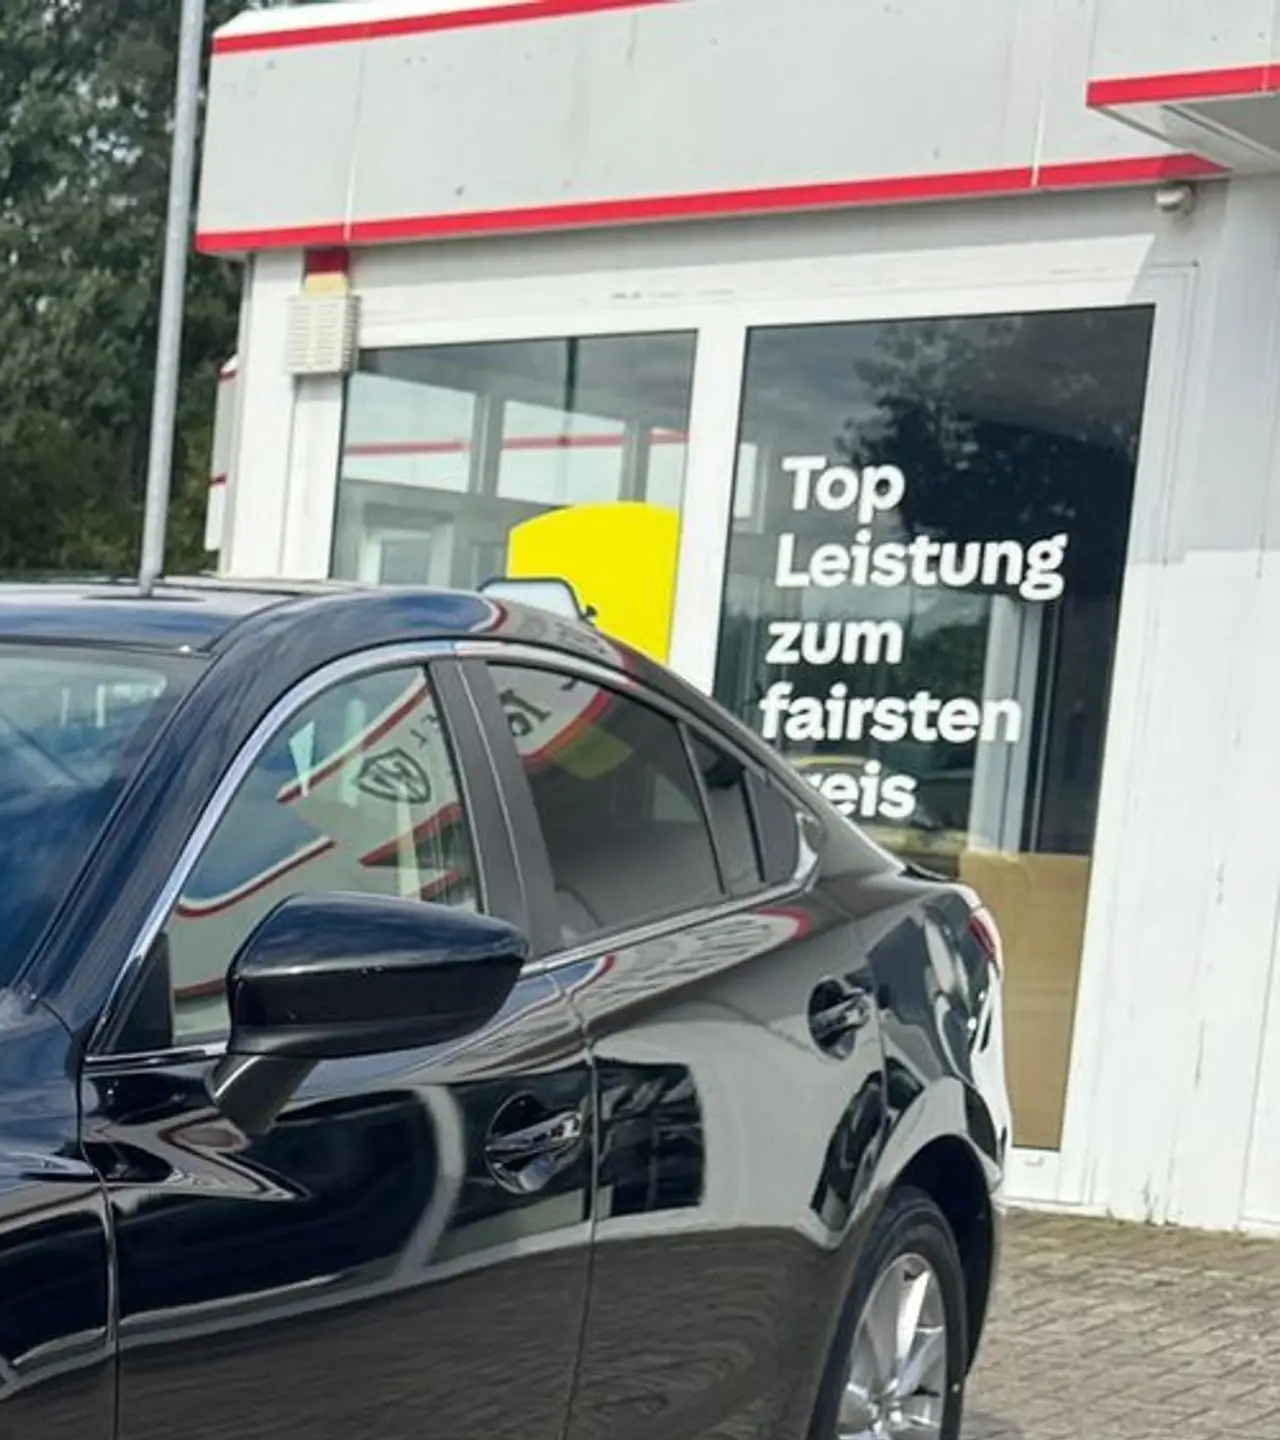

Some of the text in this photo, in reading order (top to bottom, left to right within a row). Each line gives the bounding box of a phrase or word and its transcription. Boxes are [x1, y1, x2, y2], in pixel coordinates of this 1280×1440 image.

[781, 455, 906, 525] Top
[774, 528, 1070, 602] Leistung
[765, 619, 904, 665] zum
[758, 680, 1023, 742] fairsten
